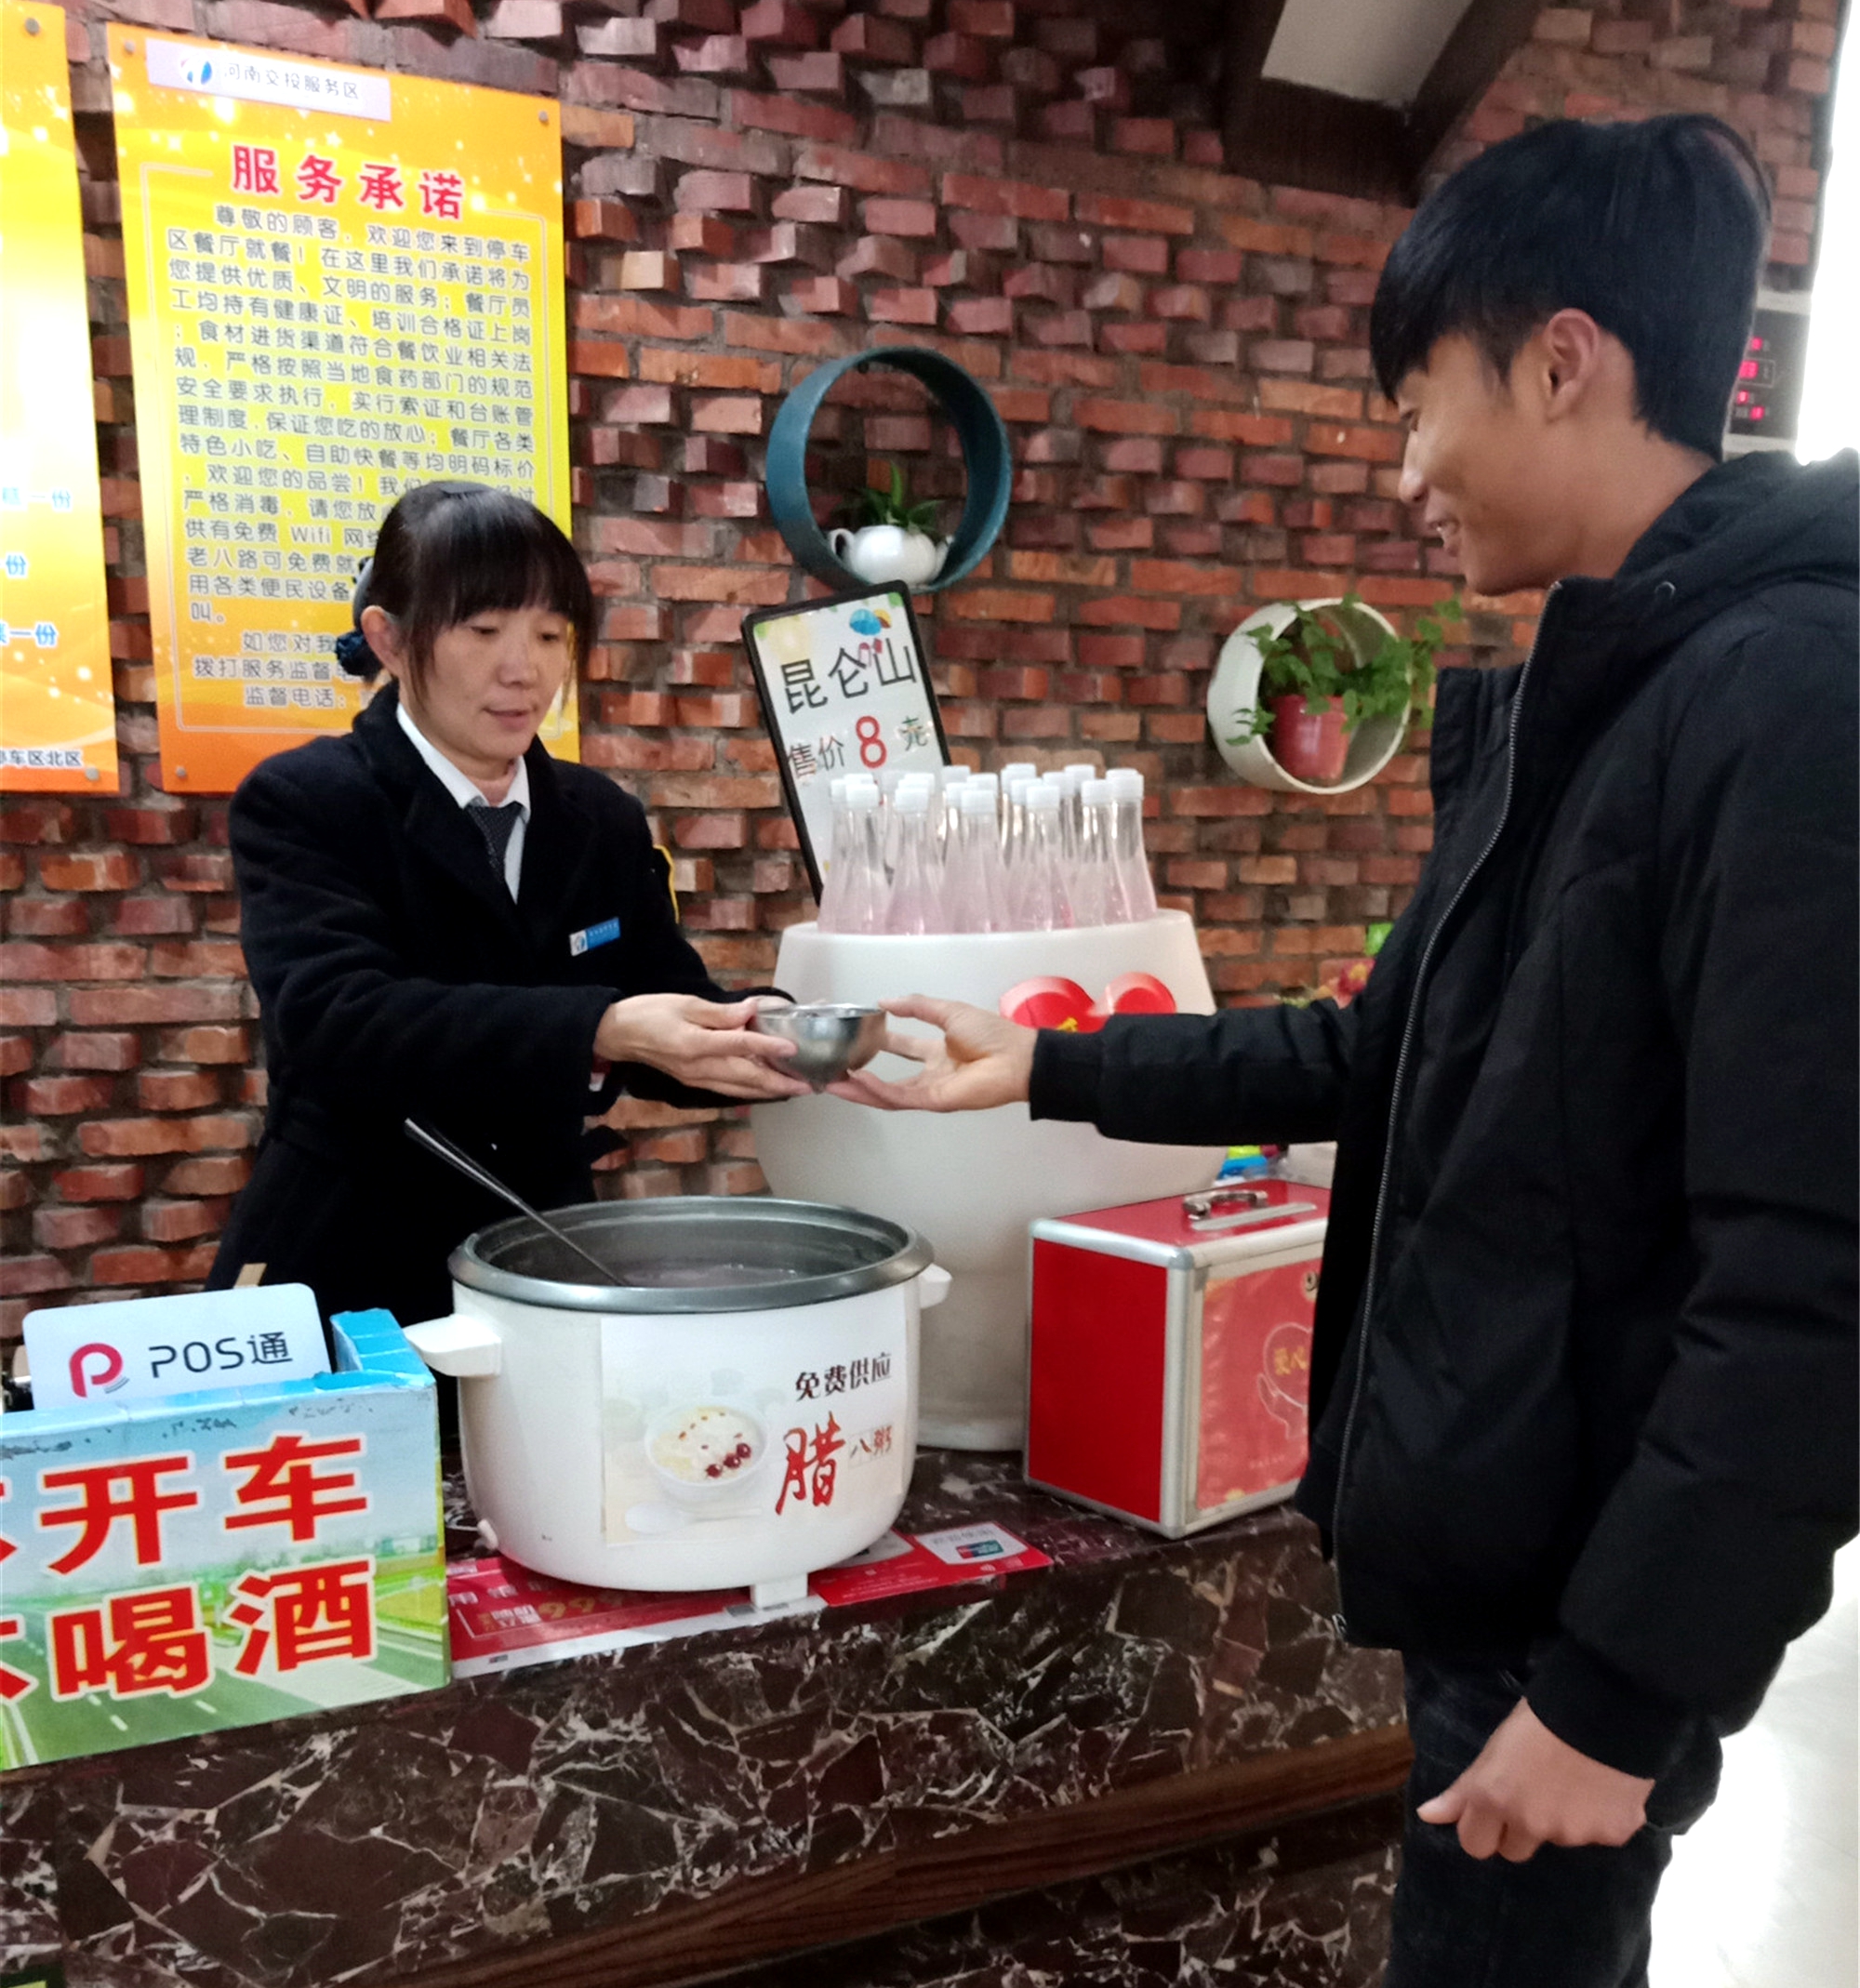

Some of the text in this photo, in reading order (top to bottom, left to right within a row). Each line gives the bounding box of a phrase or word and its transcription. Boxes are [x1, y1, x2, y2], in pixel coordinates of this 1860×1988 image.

[224, 63, 359, 99] 河南交投服务区
[232, 145, 463, 219] 服务承诺
[0, 623, 56, 645] 一份
[781, 638, 916, 714] 昆仑山
[149, 1331, 293, 1378] POS通
[795, 1352, 892, 1401] 免费供应
[0, 1436, 367, 1574] 开车
[0, 1559, 371, 1700] 喝酒
